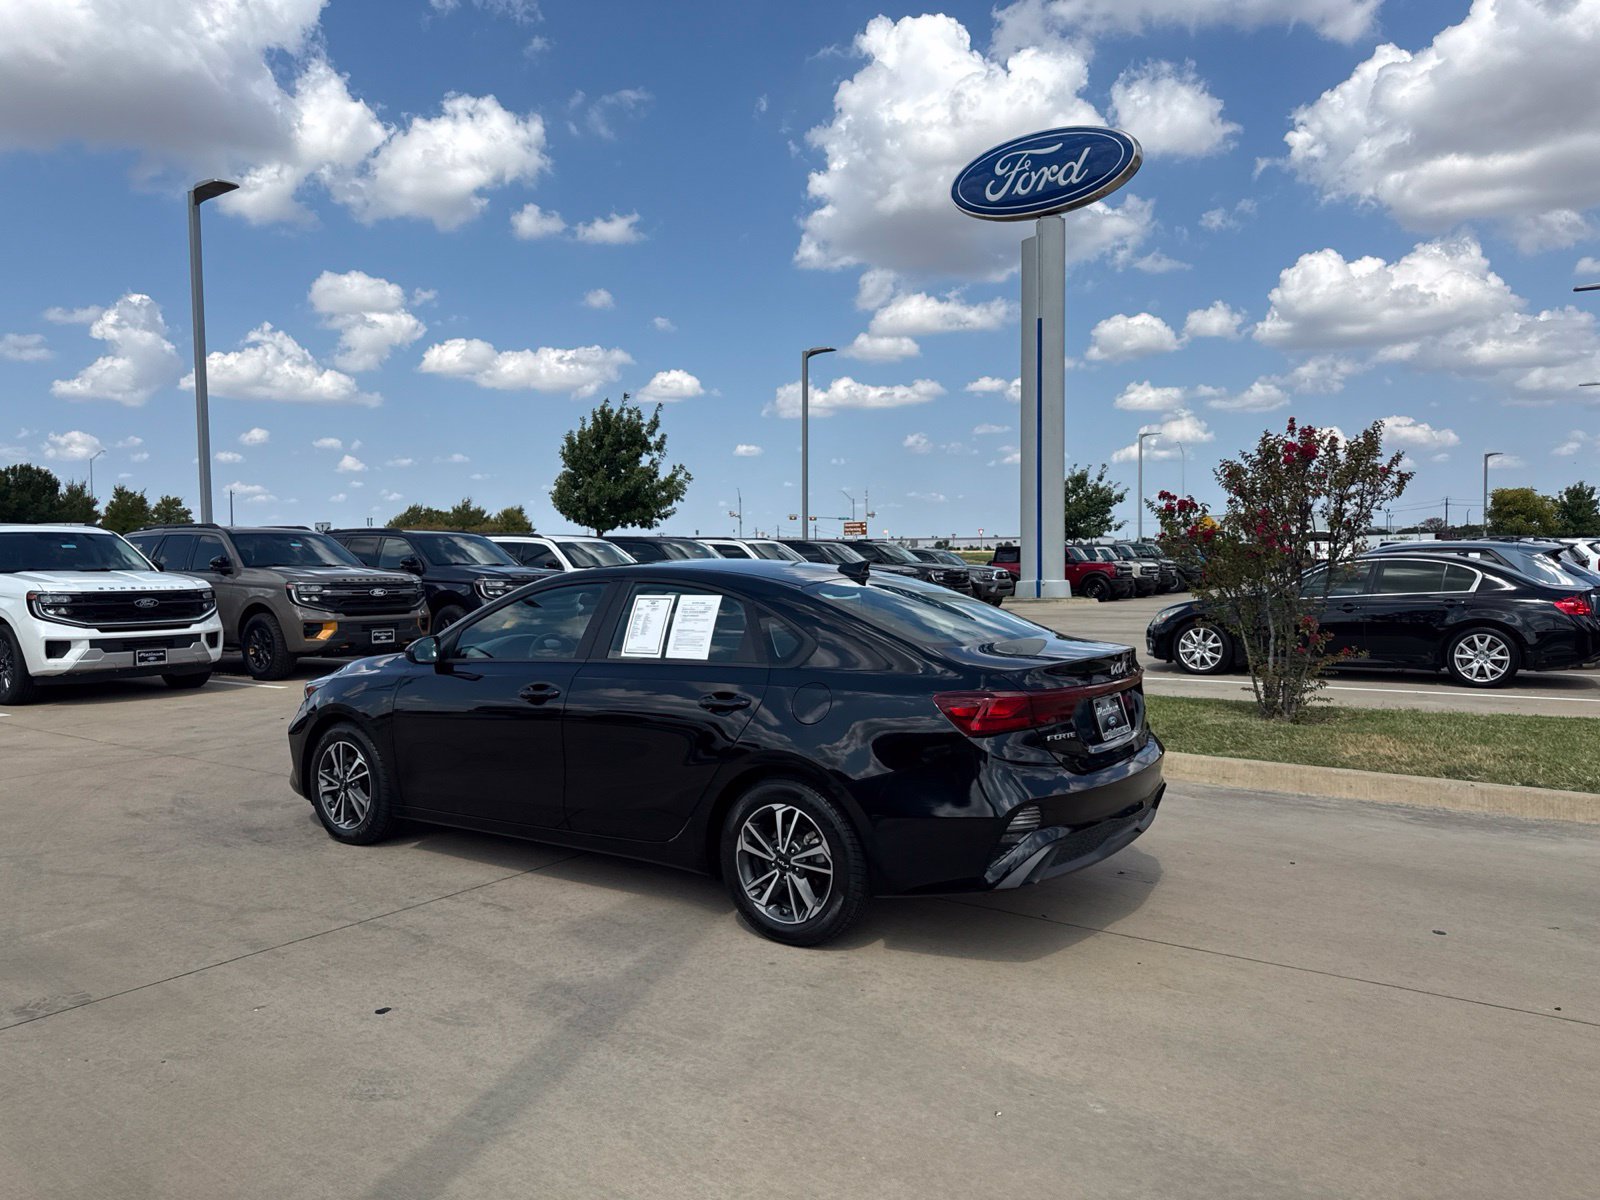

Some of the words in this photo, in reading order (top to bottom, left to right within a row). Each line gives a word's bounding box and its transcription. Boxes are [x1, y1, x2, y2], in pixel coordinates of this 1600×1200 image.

[985, 142, 1091, 202] Ford
[1110, 661, 1127, 675] KIA
[1046, 731, 1077, 742] FORTE
